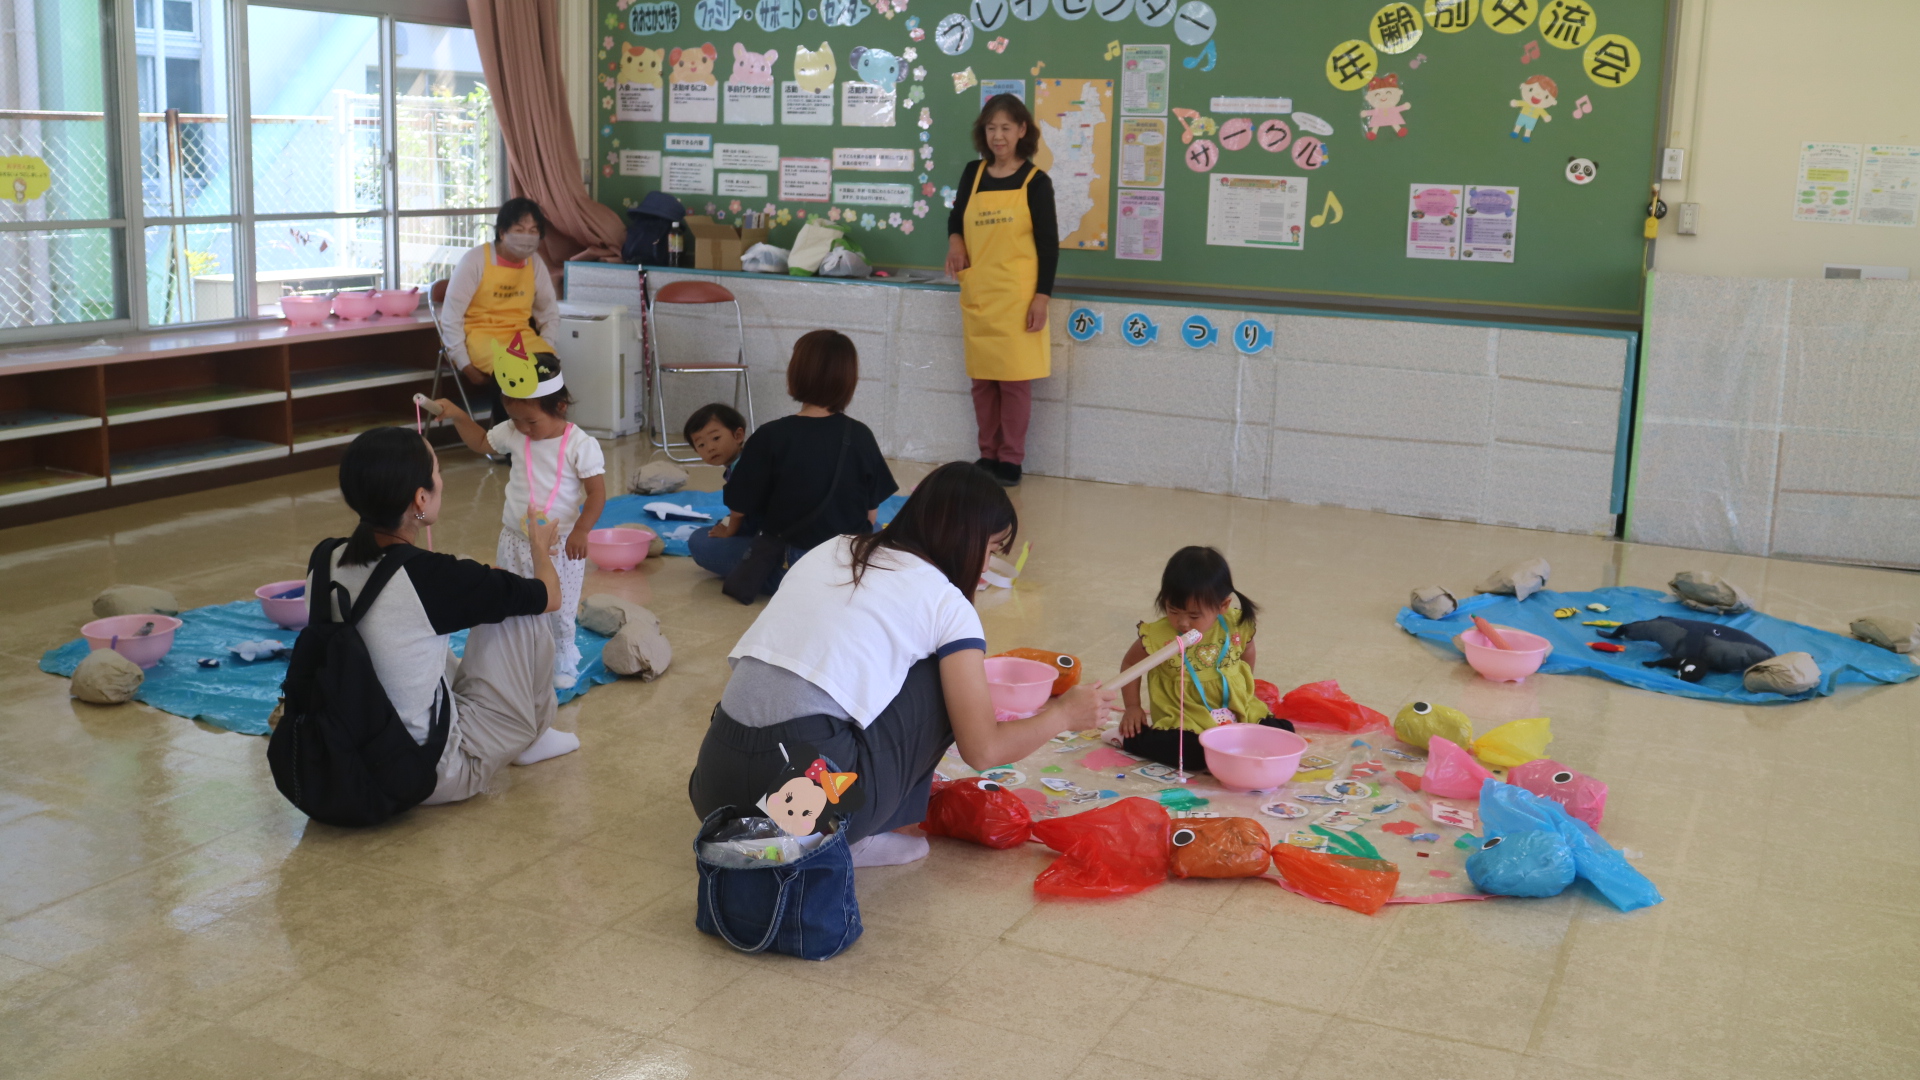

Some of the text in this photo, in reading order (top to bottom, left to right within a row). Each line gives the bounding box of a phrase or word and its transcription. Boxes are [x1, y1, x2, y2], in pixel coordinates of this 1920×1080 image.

[631, 5, 678, 33] おおさかさやま
[1333, 0, 1632, 85] 年齢別交流会
[672, 84, 708, 92] 活動するには
[726, 85, 771, 94] 事前打ち合わせ
[784, 85, 799, 93] 活動
[1190, 123, 1319, 168] サークル
[1075, 313, 1258, 347] かなつり
